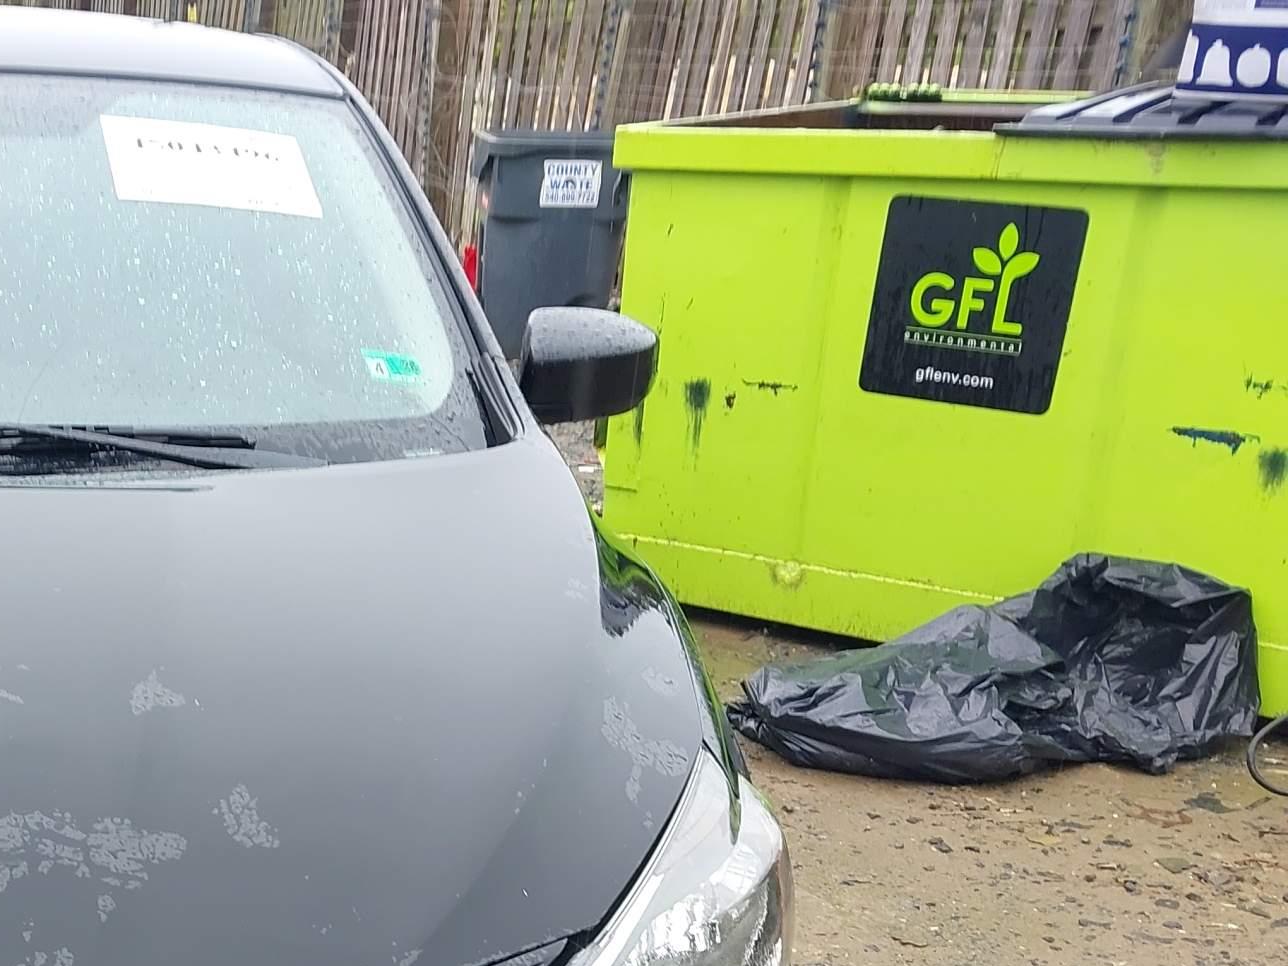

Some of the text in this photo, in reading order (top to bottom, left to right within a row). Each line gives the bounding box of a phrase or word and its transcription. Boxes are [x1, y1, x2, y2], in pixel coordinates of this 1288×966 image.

[547, 163, 598, 176] COUNTY
[910, 255, 1028, 336] GFL
[904, 330, 1022, 354] environmental
[914, 366, 995, 390] gflenv.com
